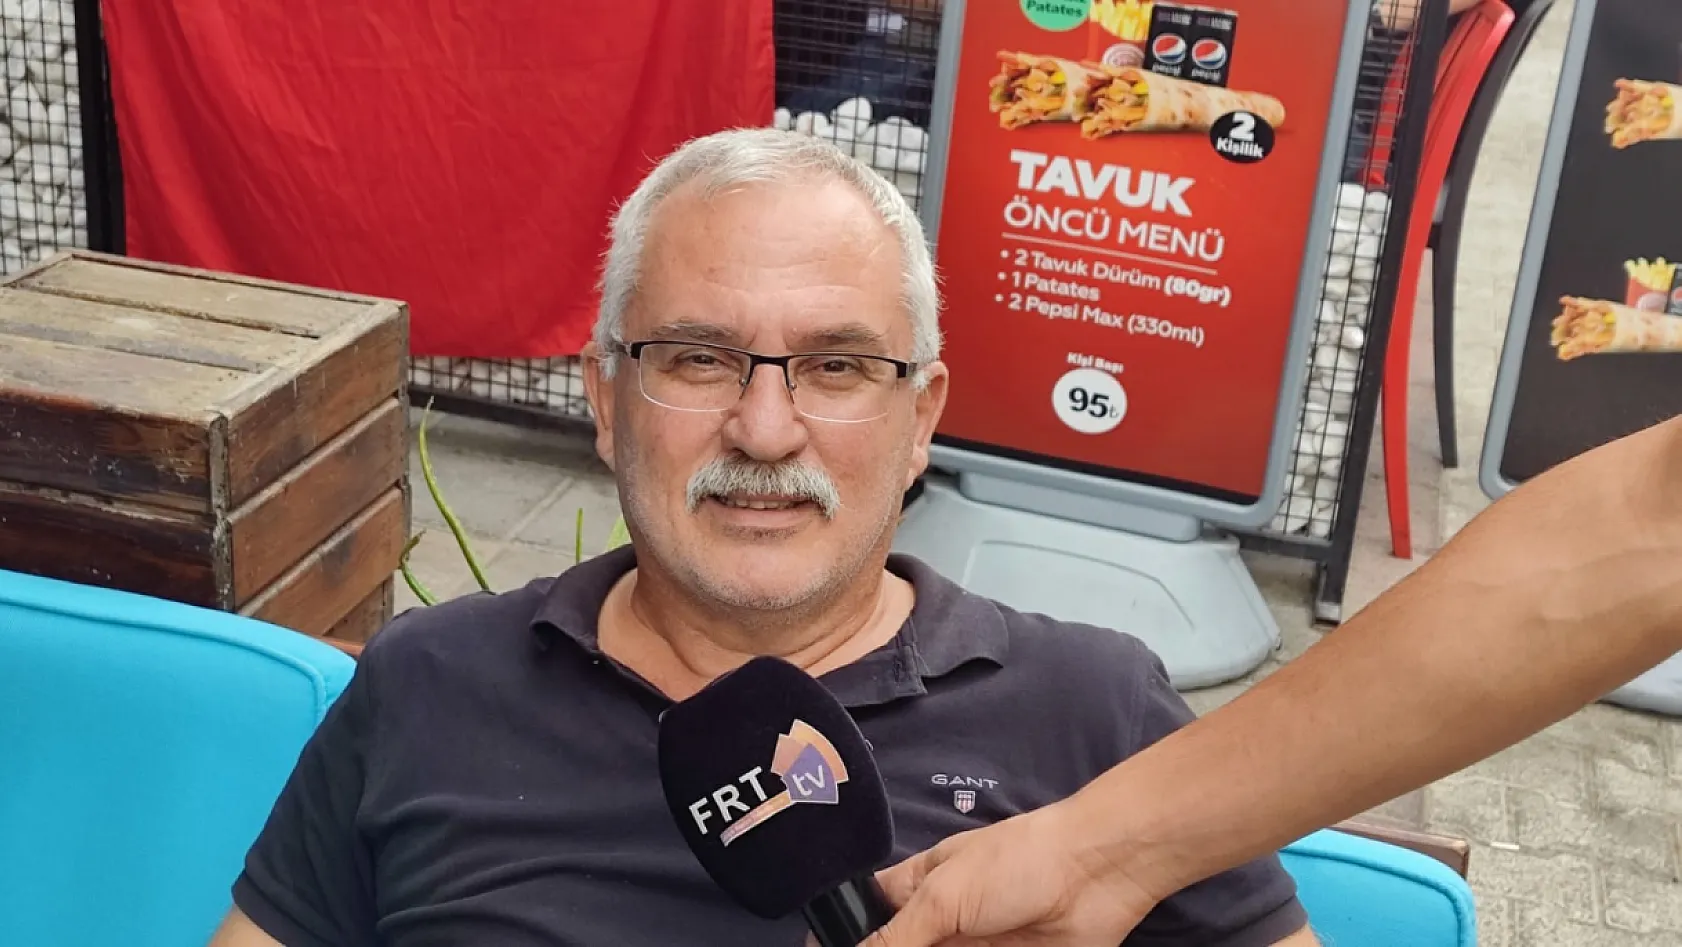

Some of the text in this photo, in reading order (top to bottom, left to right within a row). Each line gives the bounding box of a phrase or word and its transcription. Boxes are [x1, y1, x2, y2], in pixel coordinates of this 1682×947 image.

[1217, 137, 1264, 158] Kişilik
[1229, 111, 1255, 142] 2
[1010, 149, 1196, 217] TAVUK
[1003, 195, 1224, 262] ÖNCÜ MENÜ
[1012, 271, 1100, 301] 1 Patates
[1014, 249, 1232, 307] 2 Tavuk Dürüm (80gr)
[1008, 293, 1204, 348] 2 Pepsi Max (330ml)
[688, 766, 768, 835] FRT
[793, 764, 825, 796] tv
[931, 773, 999, 789] GANT
